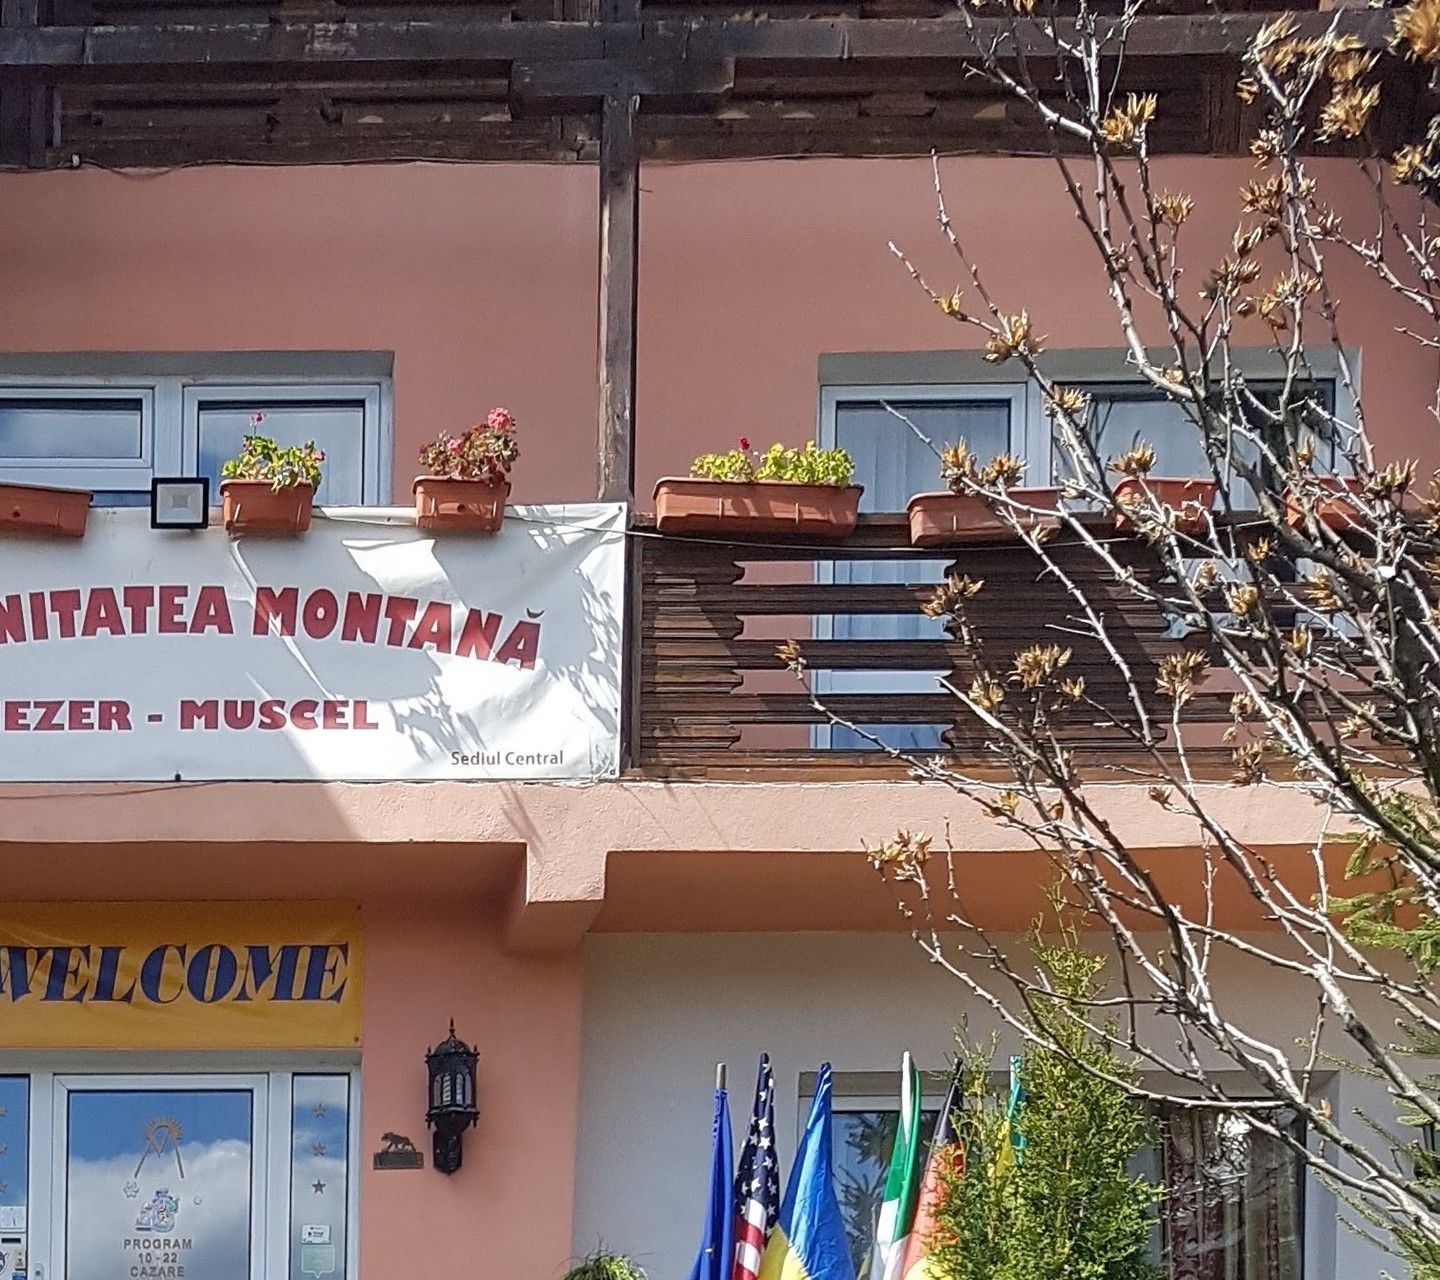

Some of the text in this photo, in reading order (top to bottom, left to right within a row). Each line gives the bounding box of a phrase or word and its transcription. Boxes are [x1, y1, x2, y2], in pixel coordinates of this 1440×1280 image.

[254, 584, 541, 672] MONTANĂ
[178, 699, 380, 732] MUSCEL
[451, 750, 564, 766] Sediul Central
[123, 1238, 192, 1250] PROGRAM
[129, 1265, 186, 1278] CAZARE
